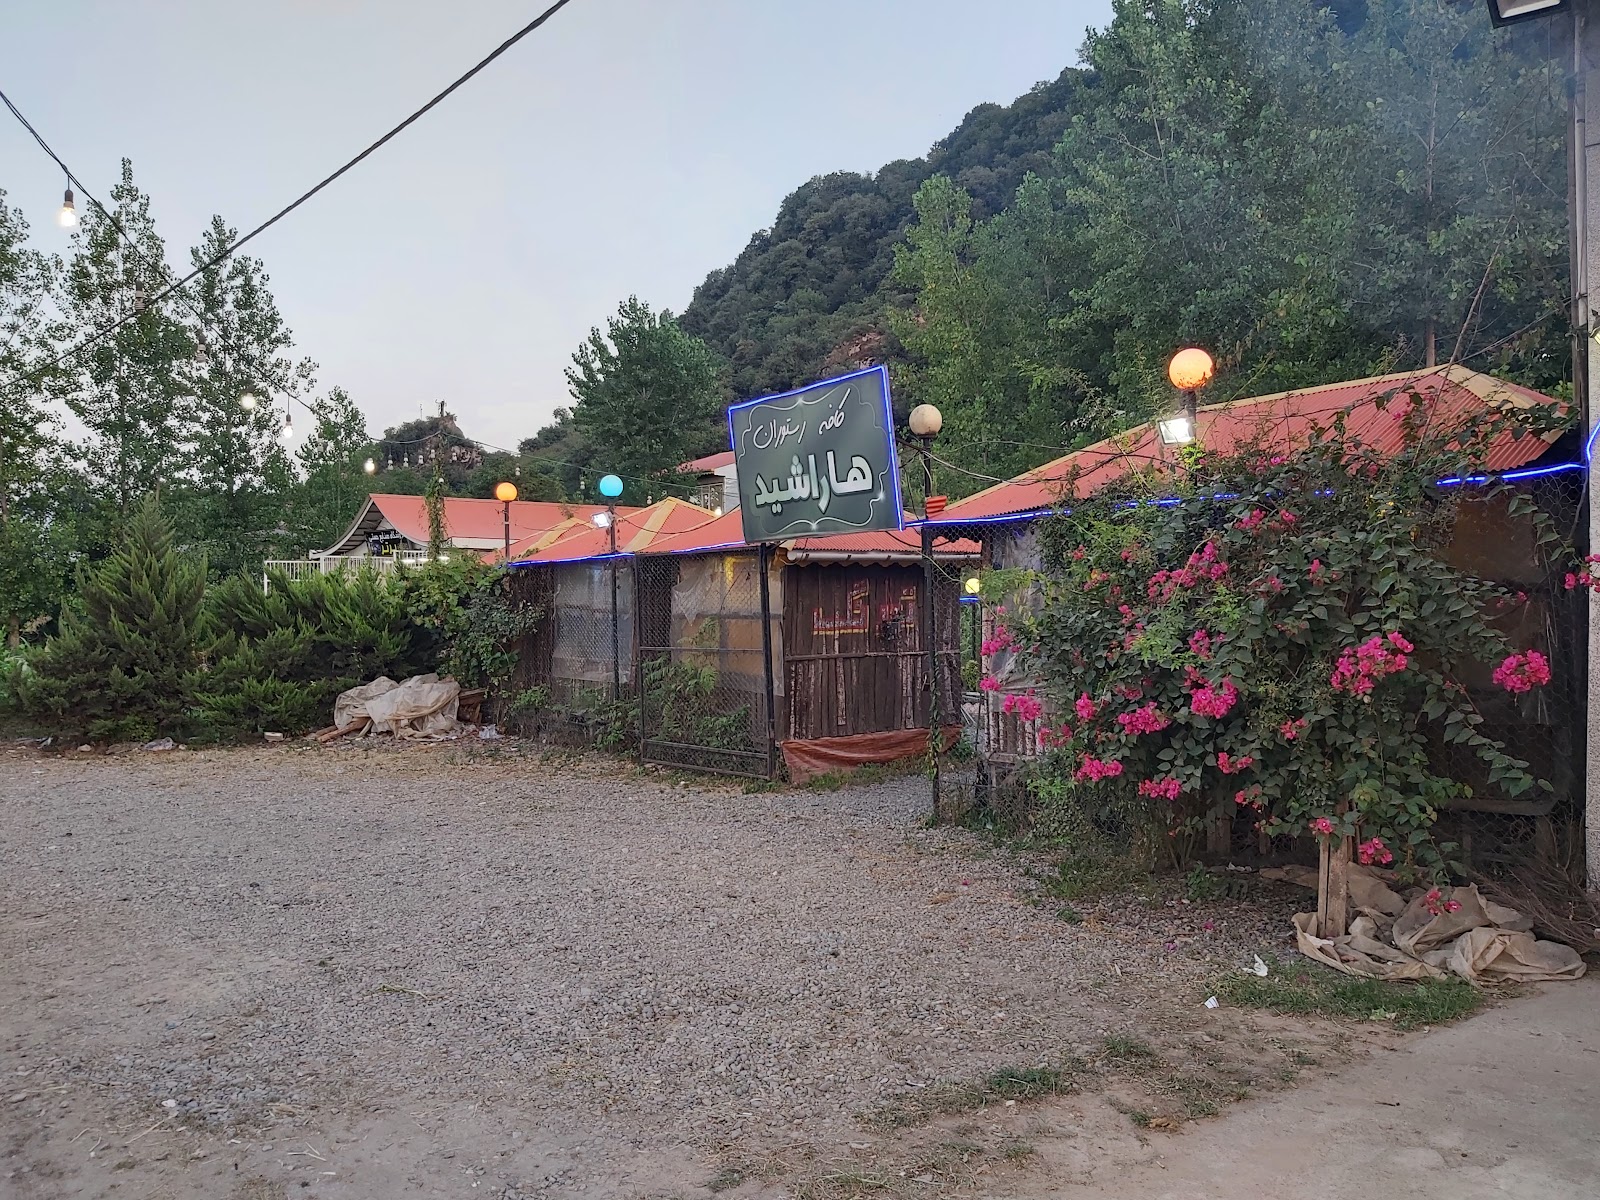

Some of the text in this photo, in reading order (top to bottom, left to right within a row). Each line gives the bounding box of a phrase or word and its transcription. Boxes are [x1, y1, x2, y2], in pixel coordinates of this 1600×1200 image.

[753, 388, 851, 449] کافه رستوران
[755, 451, 873, 514] هاراشید
